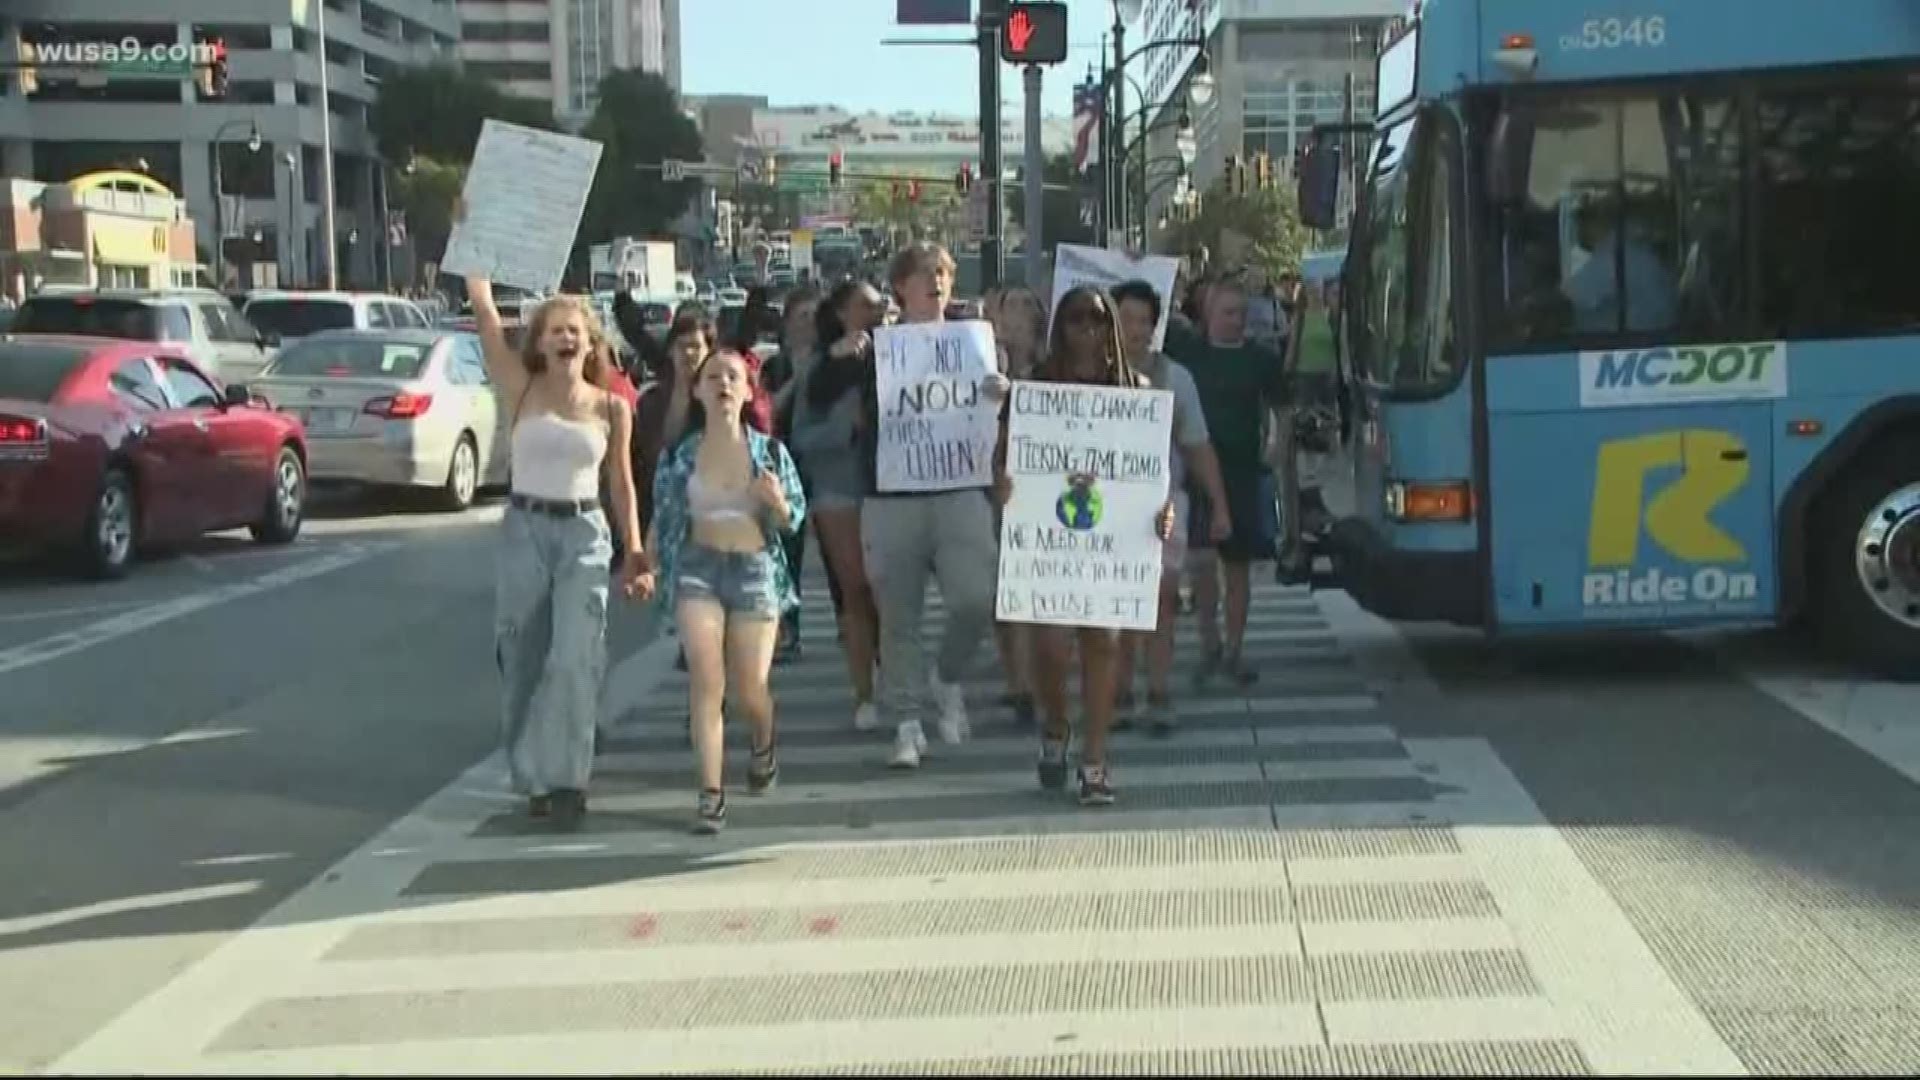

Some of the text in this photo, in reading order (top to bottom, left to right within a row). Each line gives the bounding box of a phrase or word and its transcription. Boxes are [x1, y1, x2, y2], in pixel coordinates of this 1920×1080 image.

[1583, 16, 1665, 49] 5346
[1594, 345, 1775, 389] MCDOT
[1015, 386, 1161, 424] CLIMATE CHANGE
[1012, 435, 1162, 481] TICKING TIME BOMB
[1035, 526, 1078, 553] NEED
[1583, 566, 1756, 605] Ride On
[1111, 595, 1143, 621] IT
